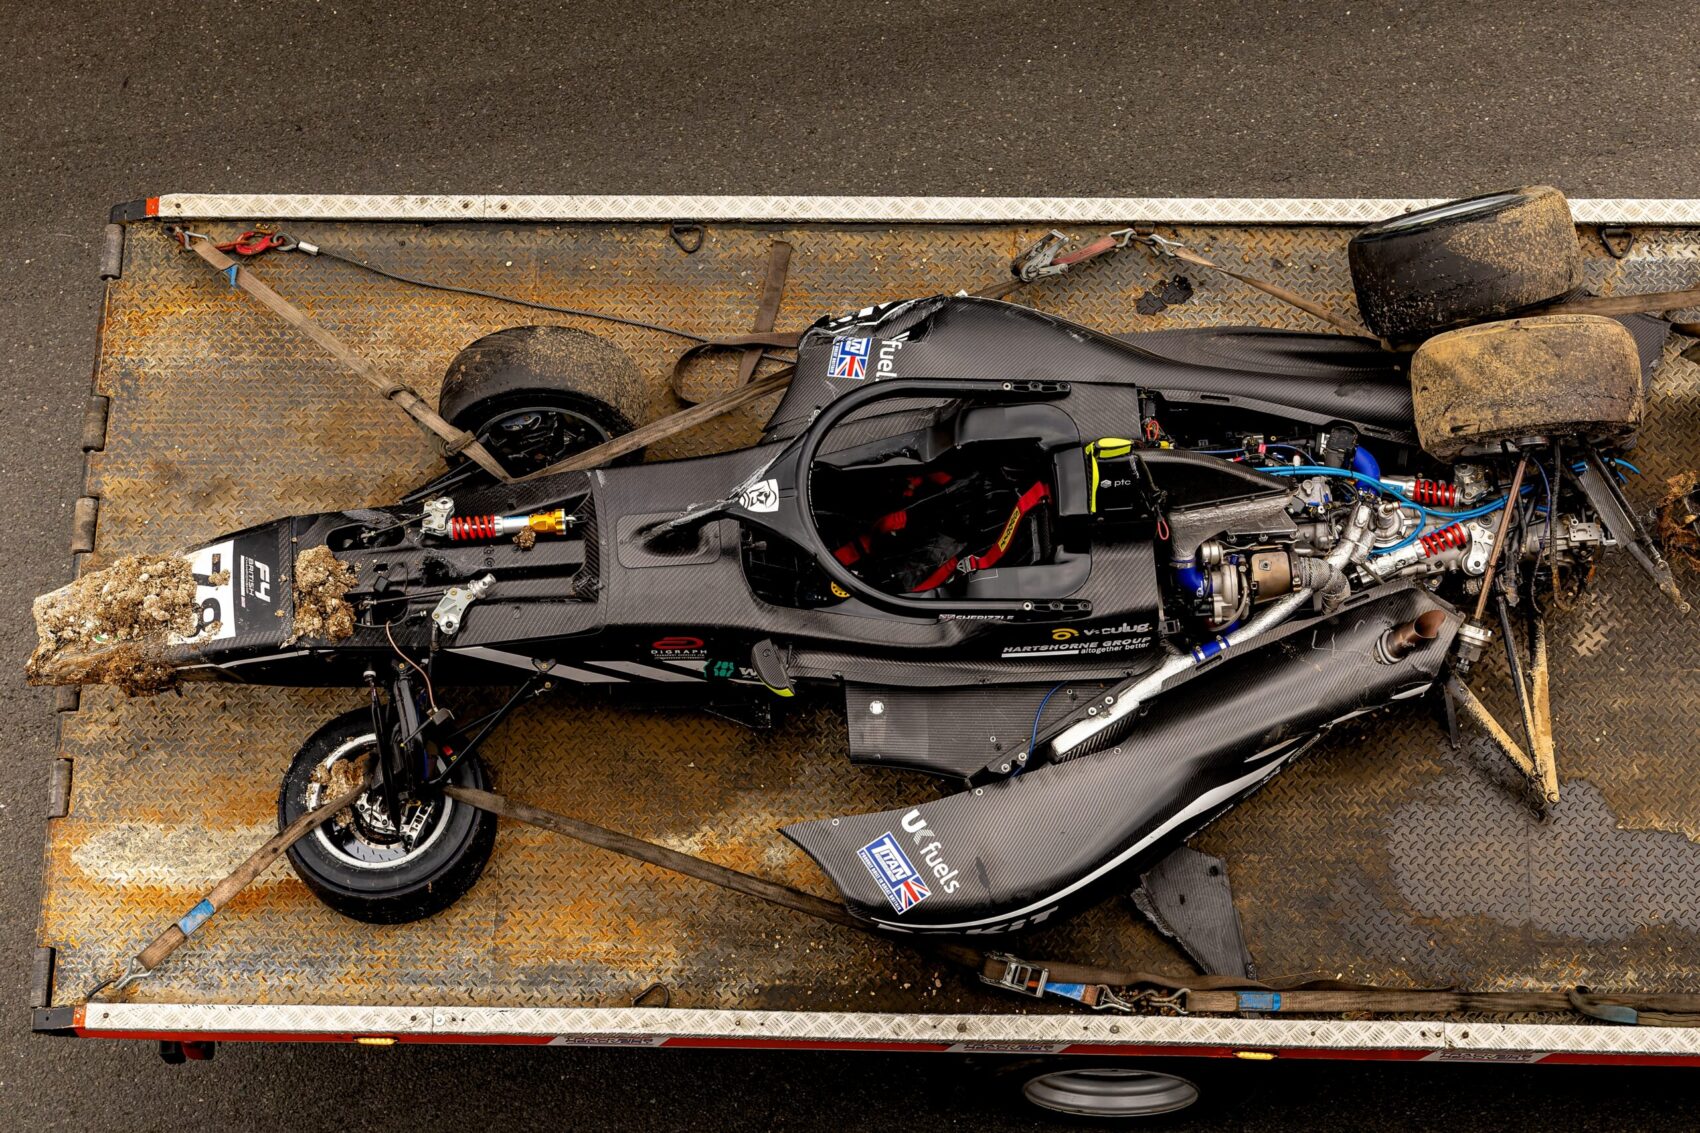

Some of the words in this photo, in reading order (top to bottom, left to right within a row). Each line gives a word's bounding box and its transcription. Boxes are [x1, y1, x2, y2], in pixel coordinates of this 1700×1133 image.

[875, 340, 902, 381] fuel
[1114, 478, 1131, 487] ptc
[254, 560, 270, 602] F4
[1003, 641, 1099, 653] HARTSHORNE
[1103, 637, 1152, 647] GROUP
[1081, 645, 1123, 654] altogether
[1125, 642, 1150, 650] better
[871, 837, 912, 882] TITAN
[920, 841, 960, 894] fuels
